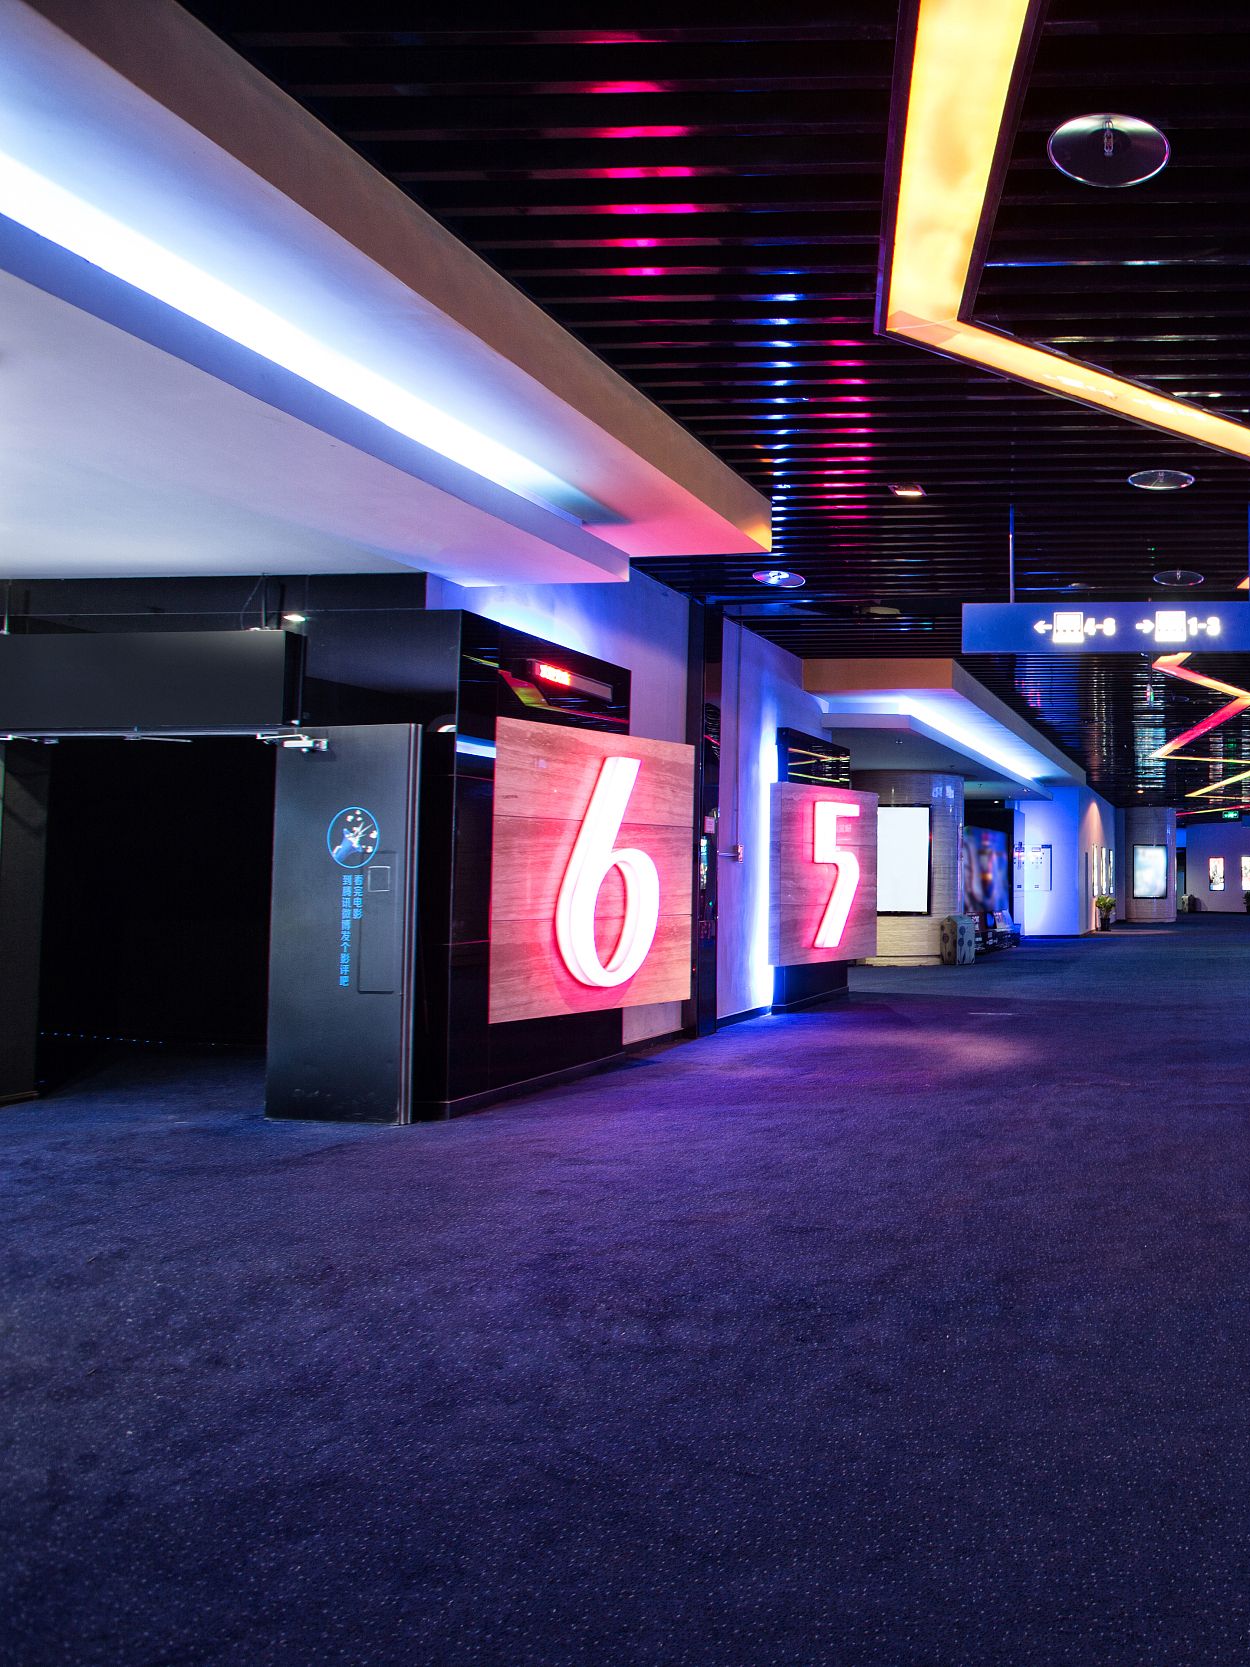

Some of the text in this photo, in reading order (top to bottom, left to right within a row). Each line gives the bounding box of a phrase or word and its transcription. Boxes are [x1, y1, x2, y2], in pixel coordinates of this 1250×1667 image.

[353, 874, 363, 919] 看完电影
[555, 756, 660, 988] 6
[814, 801, 860, 948] 5
